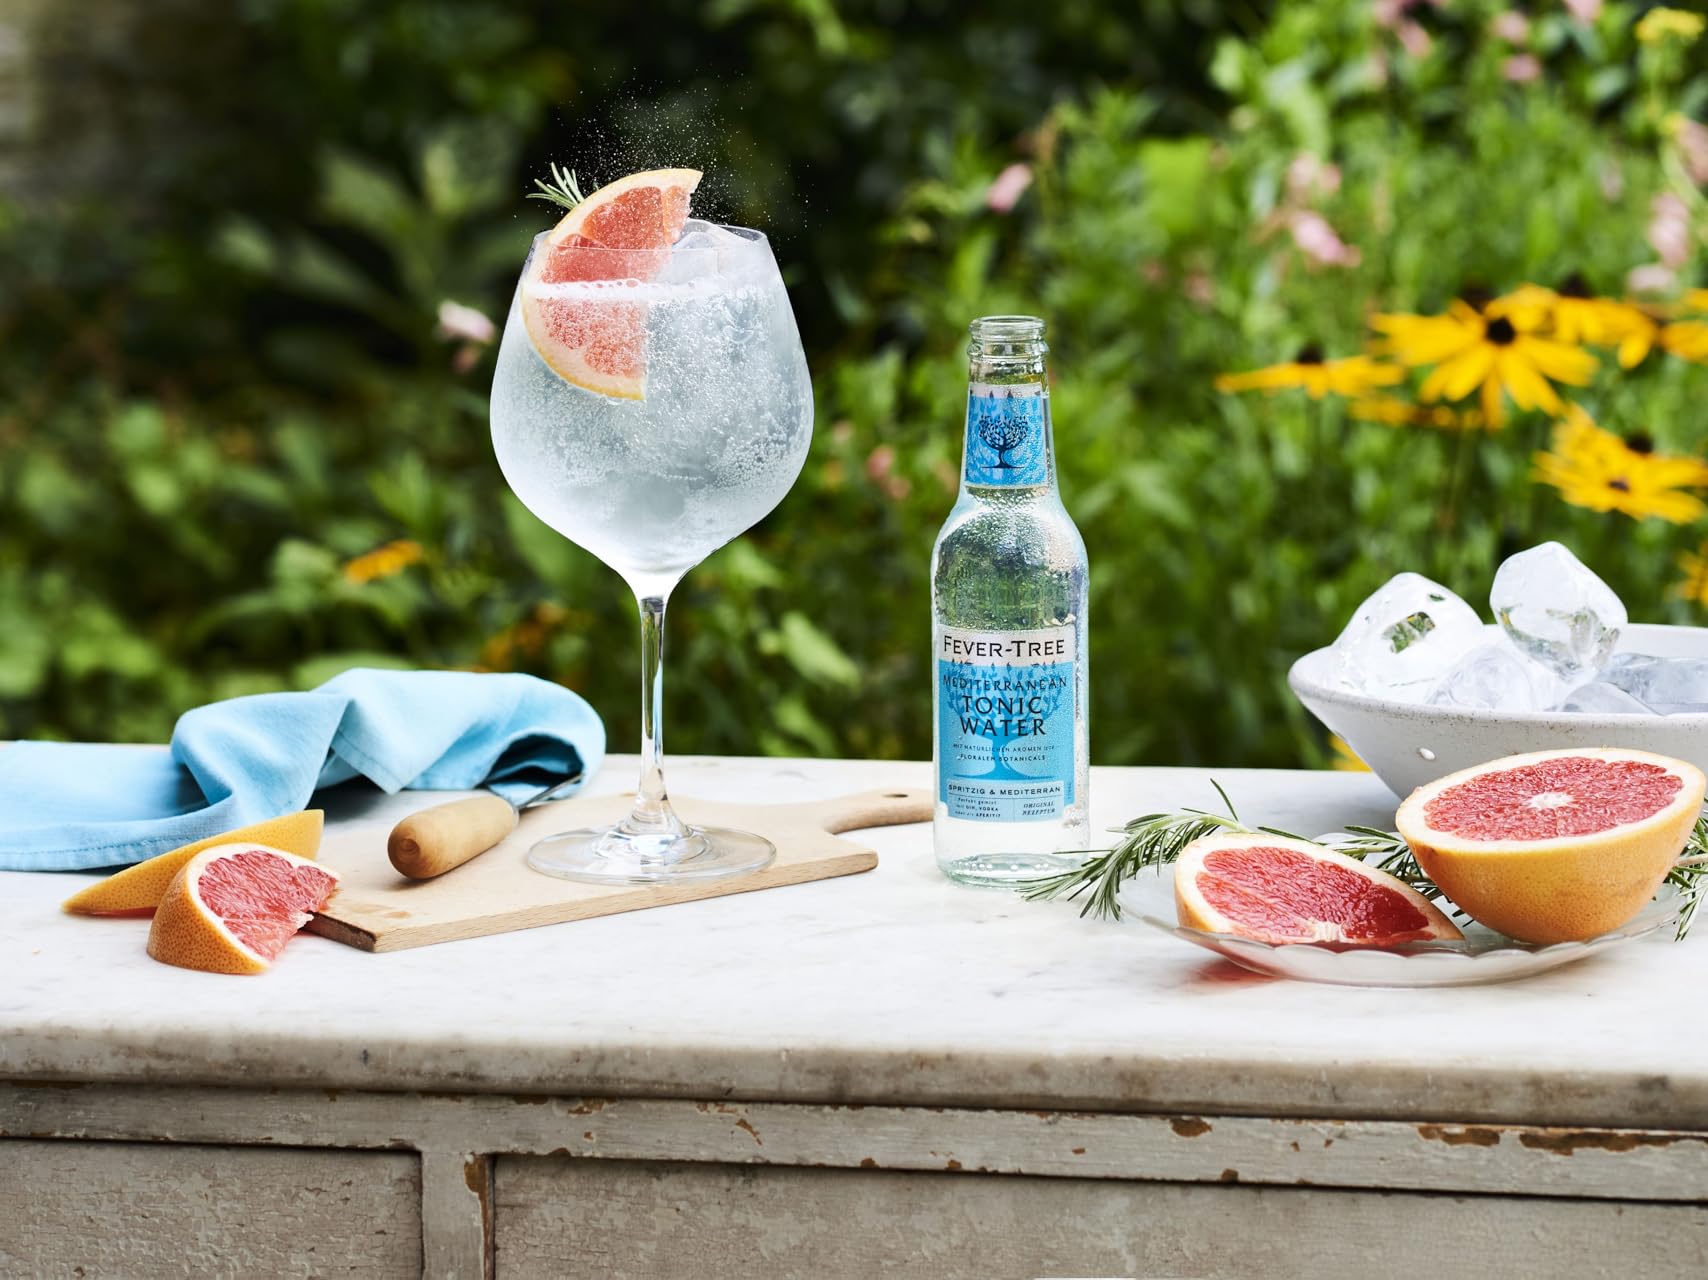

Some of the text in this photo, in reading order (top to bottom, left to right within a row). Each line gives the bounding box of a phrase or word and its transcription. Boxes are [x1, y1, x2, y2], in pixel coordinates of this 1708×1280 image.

[944, 635, 1065, 657] FEVER-TREE
[943, 674, 1067, 691] MEDITERRANEAN
[962, 695, 1042, 715] TONIC
[960, 716, 1046, 737] WATER
[999, 754, 1046, 762] BOTANICALS
[948, 784, 986, 795] SPRITZIG
[1000, 786, 1061, 795] MEDITERRAN
[1023, 801, 1055, 809] ORIGINAL
